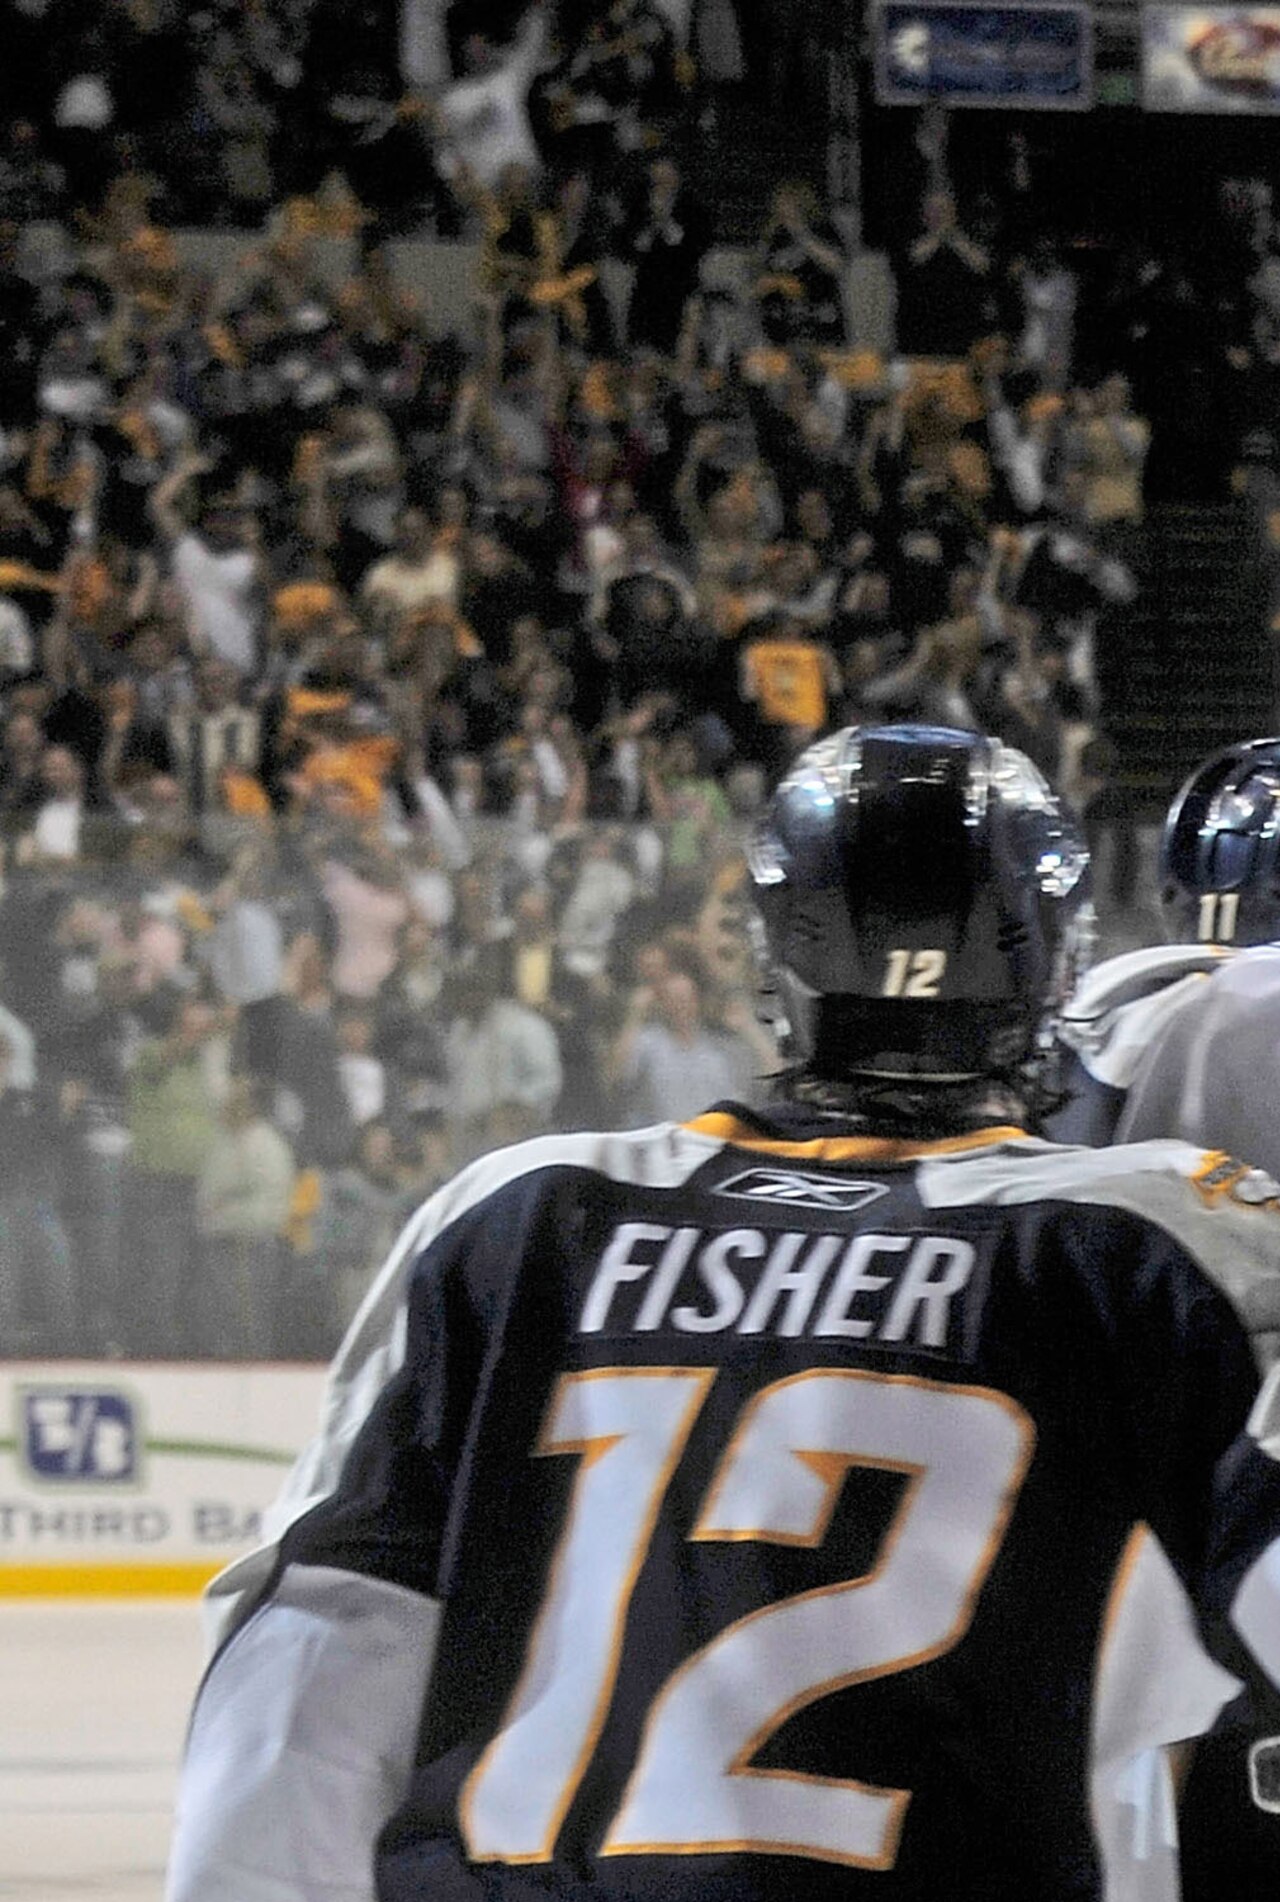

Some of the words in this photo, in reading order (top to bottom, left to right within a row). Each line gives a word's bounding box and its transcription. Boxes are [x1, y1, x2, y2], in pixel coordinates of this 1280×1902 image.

[1198, 893, 1240, 940] 11
[882, 949, 947, 997] 12
[579, 1222, 976, 1348] FISHER
[459, 1366, 1037, 1871] 12
